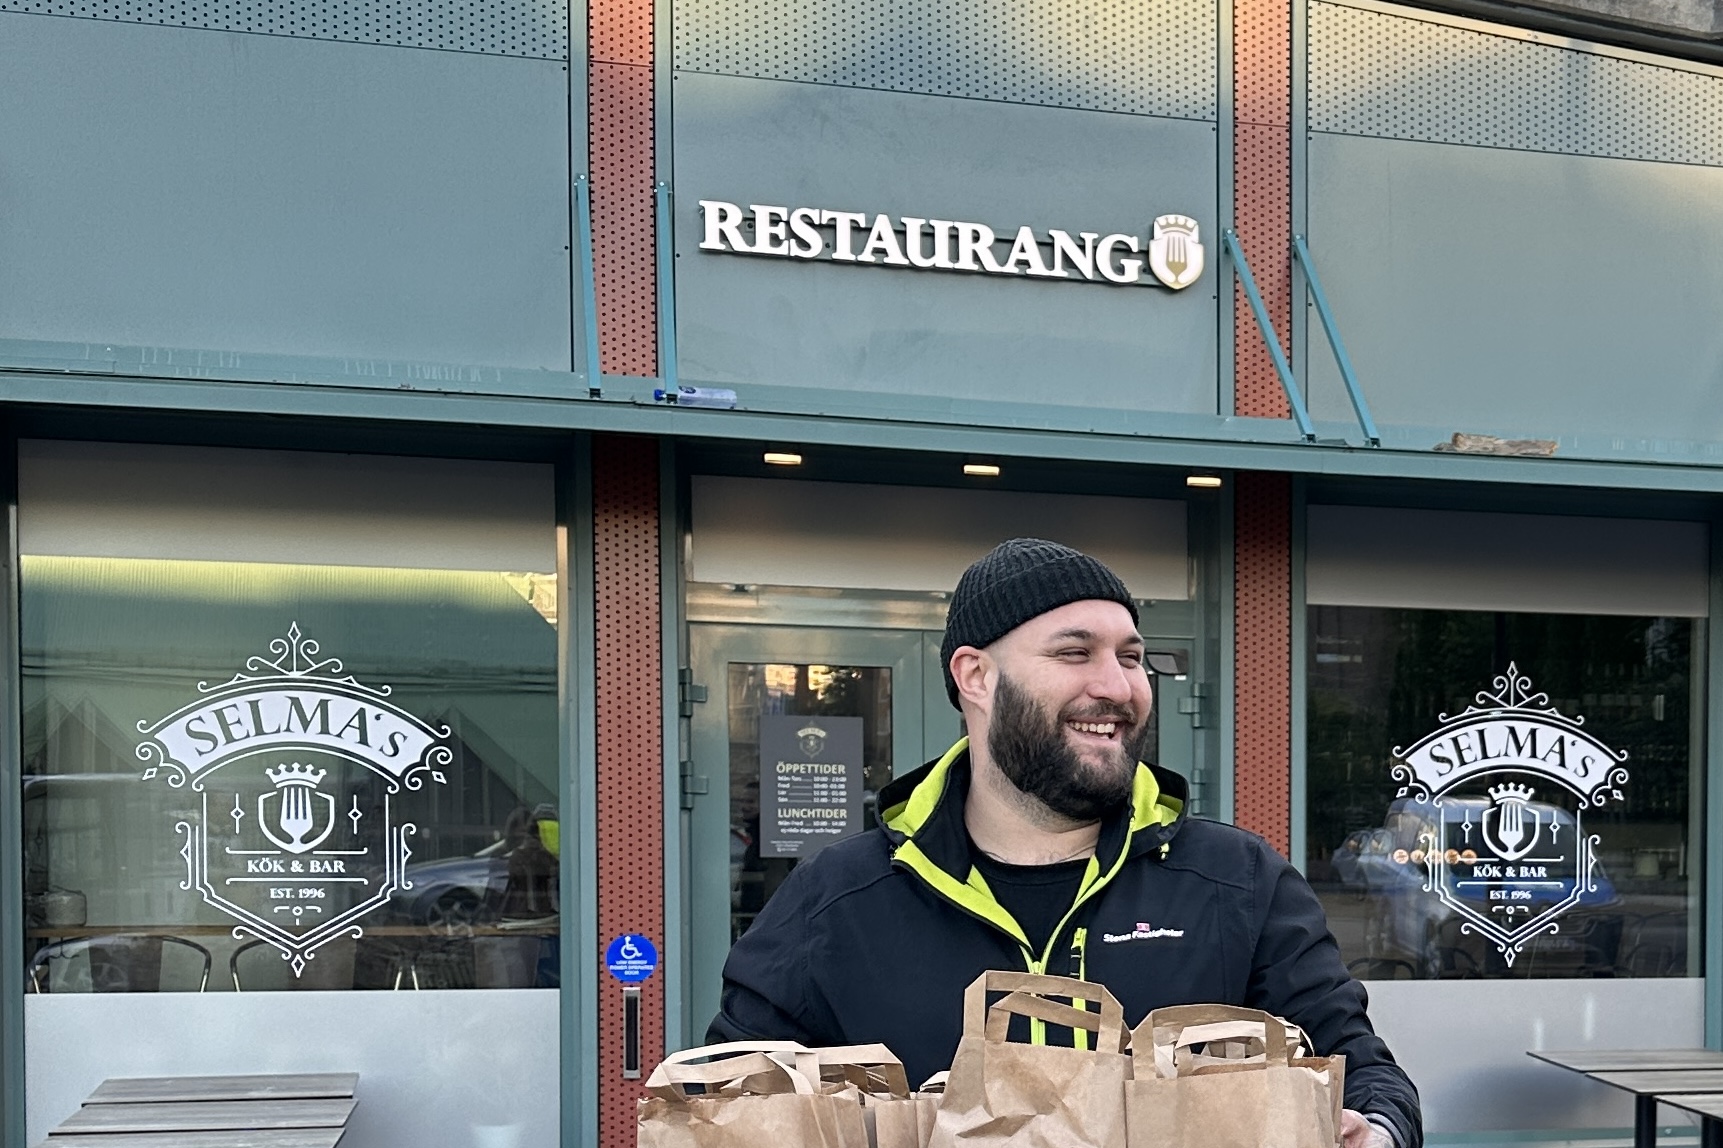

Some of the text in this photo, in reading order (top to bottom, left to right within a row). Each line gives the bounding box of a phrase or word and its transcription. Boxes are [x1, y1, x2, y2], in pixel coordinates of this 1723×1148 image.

[699, 200, 1142, 284] RESTAURANG
[184, 695, 409, 758] SELMA'S
[1429, 725, 1596, 779] SELMA'S
[776, 761, 846, 774] ÖPPETTIDER
[777, 808, 847, 819] LUNCHTIDER
[247, 857, 346, 873] KÖK & BAR
[1473, 864, 1547, 878] KÖK & BAR
[269, 888, 326, 899] EST. 1996
